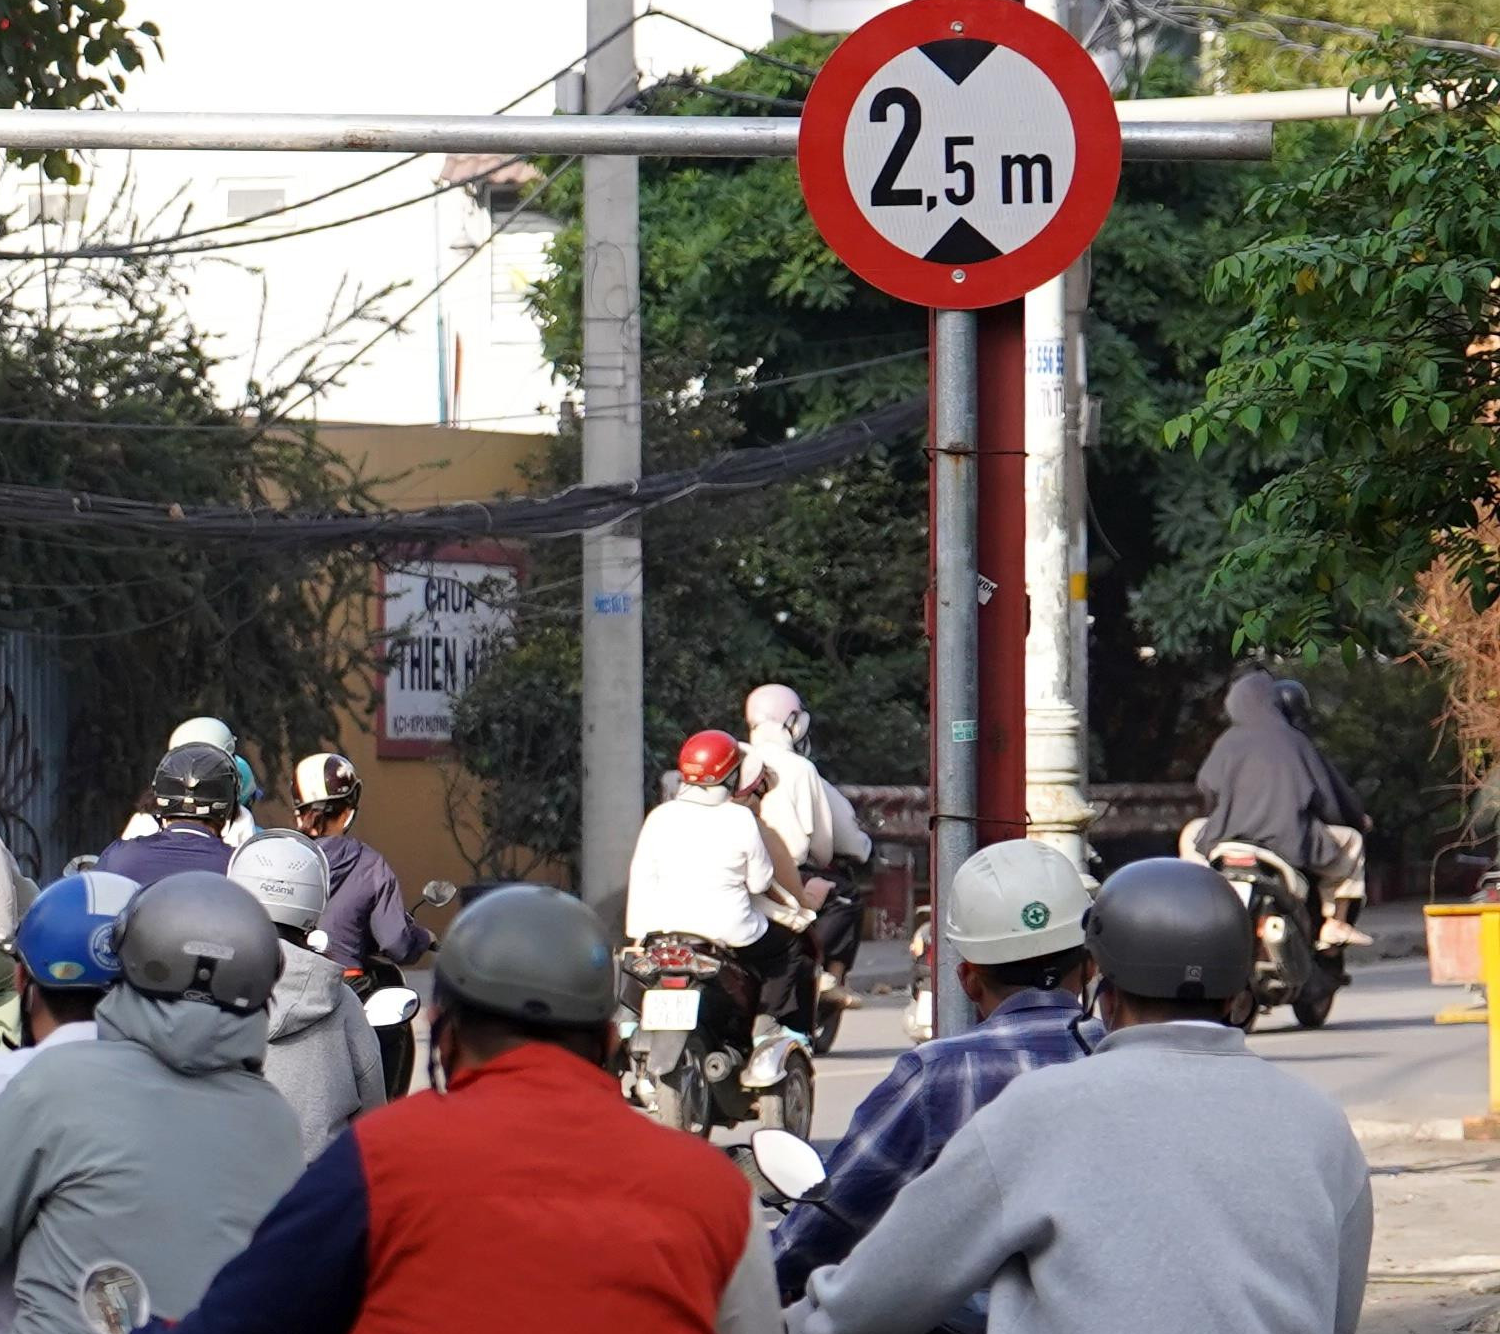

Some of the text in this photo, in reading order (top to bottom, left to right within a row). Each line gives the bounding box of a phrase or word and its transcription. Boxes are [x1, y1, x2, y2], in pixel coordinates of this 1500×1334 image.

[869, 85, 1054, 213] 2,5 m
[259, 880, 295, 897] Aptamil
